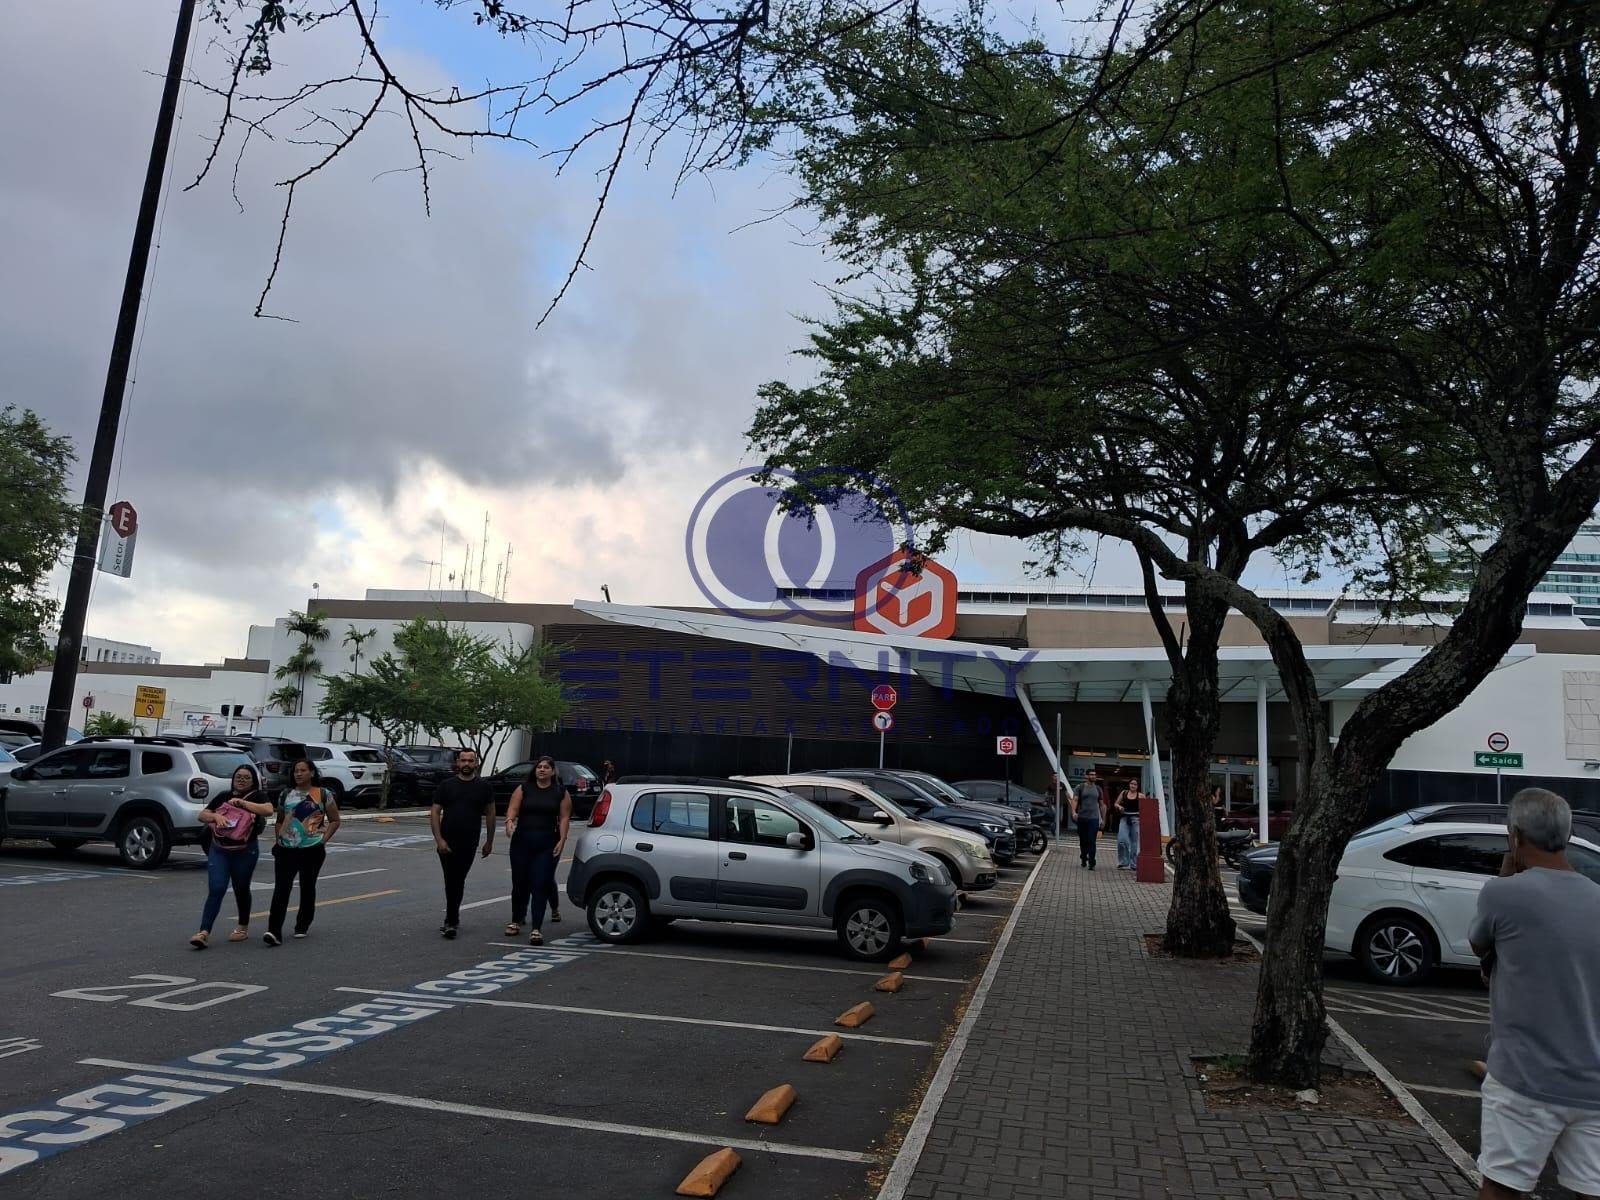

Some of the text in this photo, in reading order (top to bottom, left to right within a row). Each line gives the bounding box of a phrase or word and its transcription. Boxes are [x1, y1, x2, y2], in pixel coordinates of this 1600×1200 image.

[119, 507, 131, 530] E
[113, 542, 124, 571] Setor
[873, 693, 895, 702] PARE
[1001, 741, 1012, 750] E9
